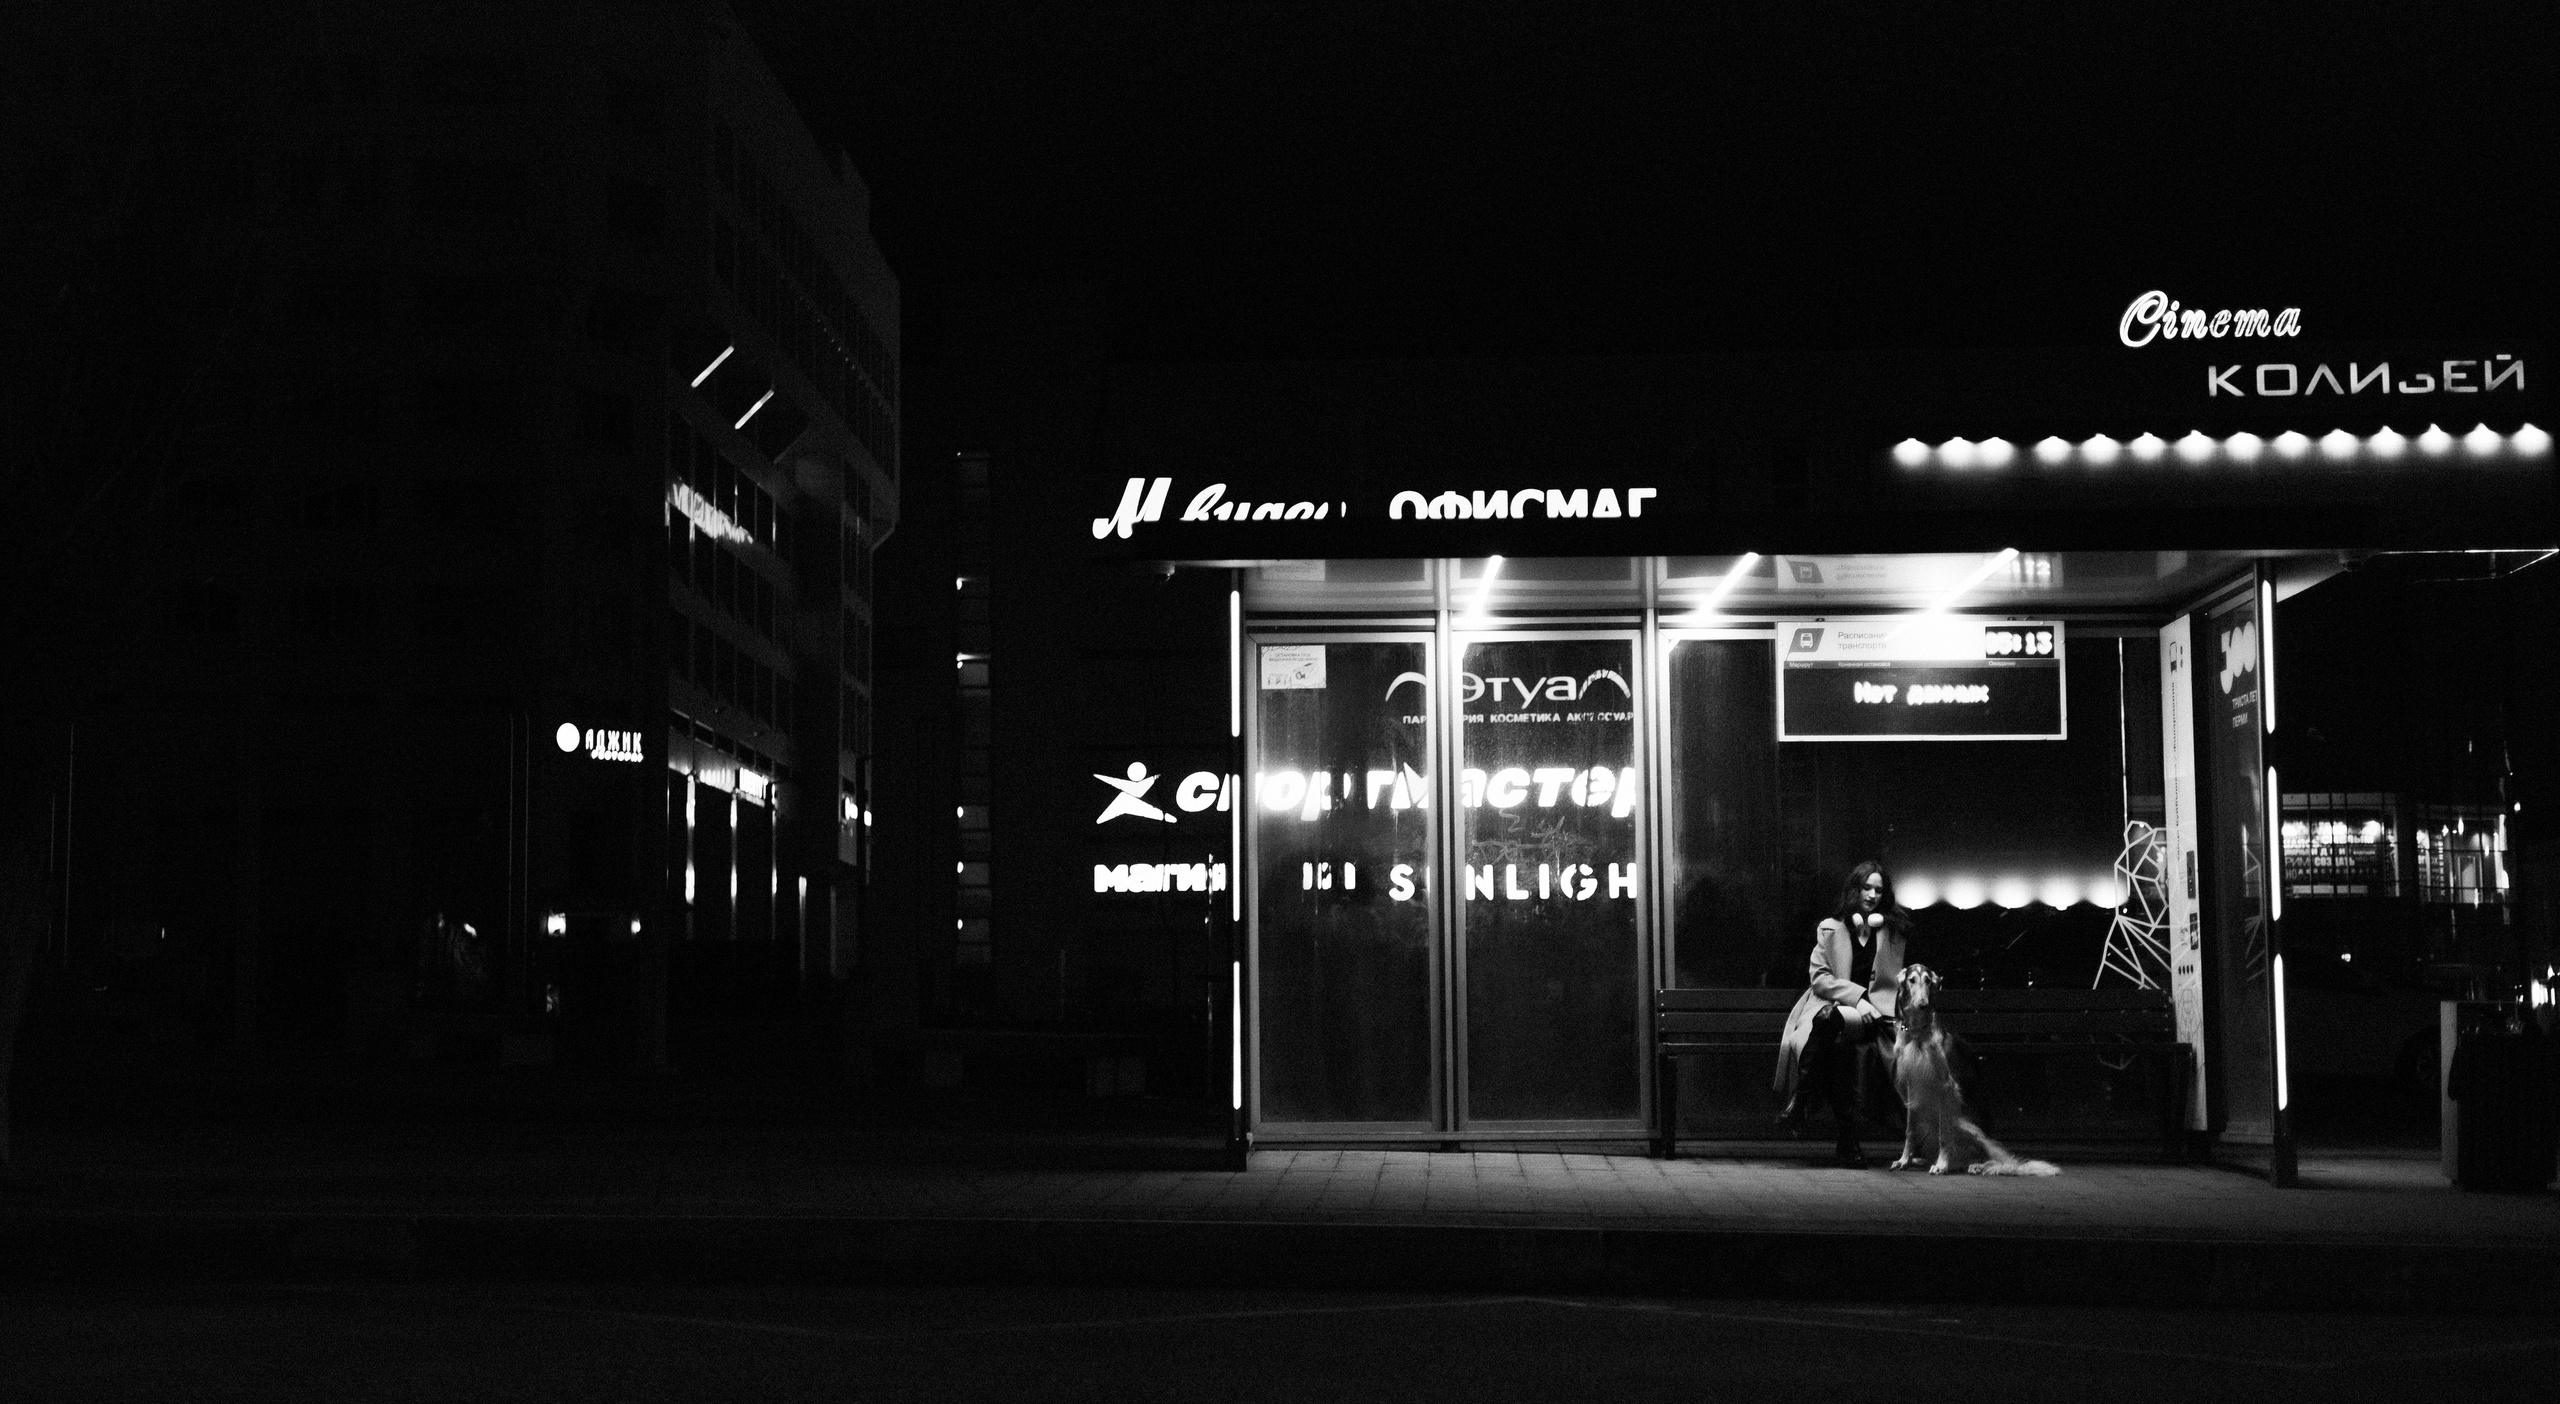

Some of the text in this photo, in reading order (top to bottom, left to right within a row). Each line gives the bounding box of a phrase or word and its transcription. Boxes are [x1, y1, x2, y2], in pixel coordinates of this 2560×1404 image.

[2119, 290, 2301, 348] Cinema
[1490, 713, 1561, 723] КОСМЕТИКА
[1389, 862, 1637, 901] SNLIGH
